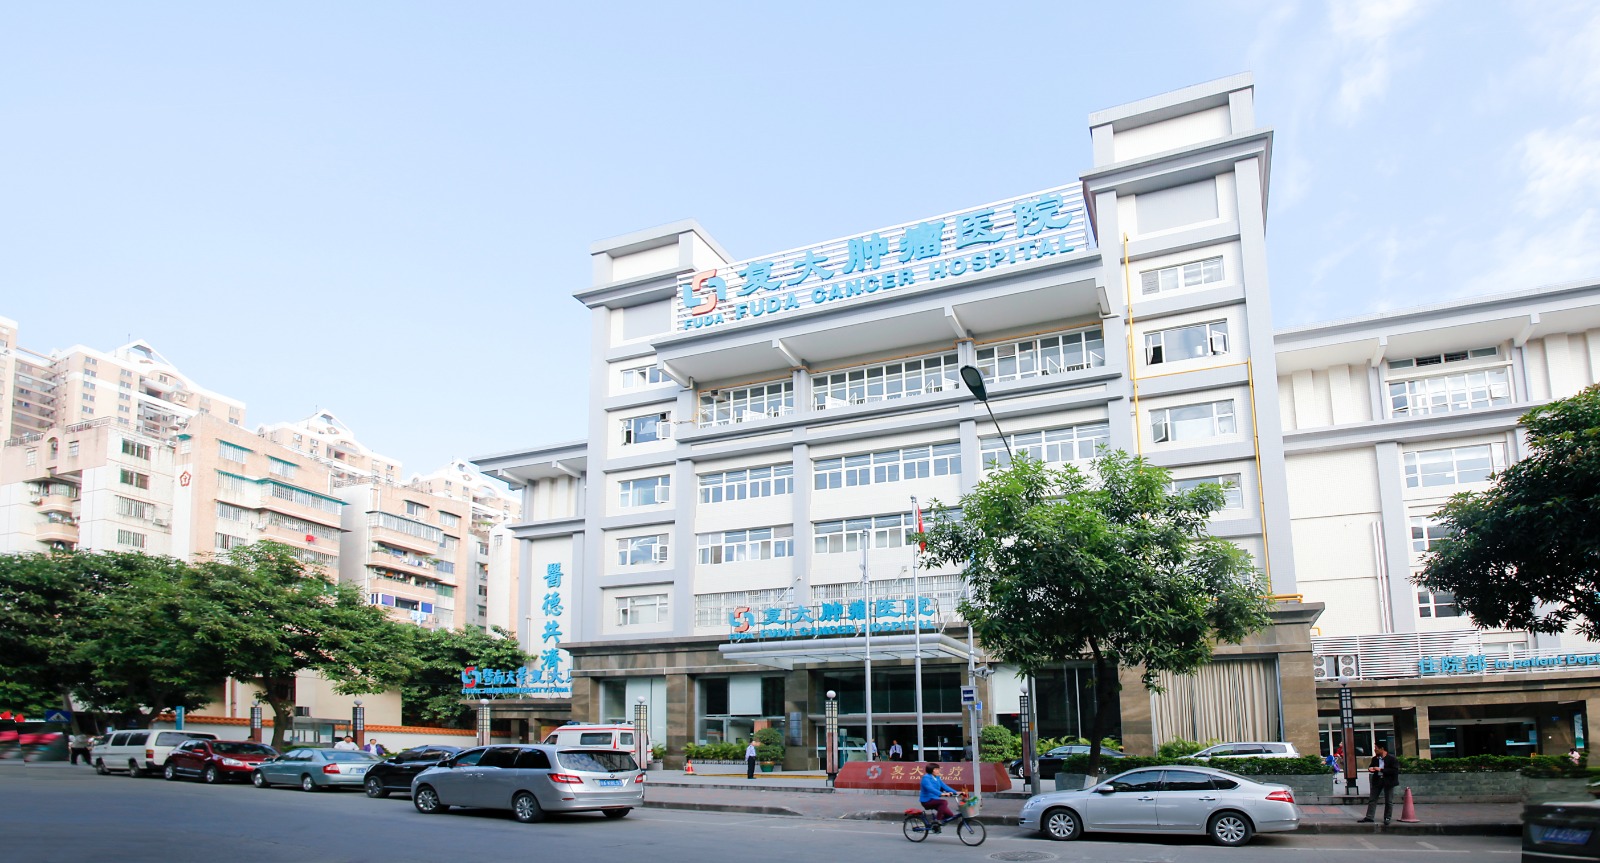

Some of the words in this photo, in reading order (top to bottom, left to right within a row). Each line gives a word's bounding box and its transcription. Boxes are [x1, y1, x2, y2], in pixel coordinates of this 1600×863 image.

[736, 193, 1073, 298] 复大肿瘤医院
[735, 292, 800, 321] FUDA
[811, 268, 916, 304] CANCER
[928, 235, 1075, 281] HOSPITAL
[682, 314, 726, 331] FUDA
[759, 595, 936, 625] 复大肿瘤医院
[728, 632, 755, 640] FUDA
[760, 627, 797, 638] FUDA
[800, 624, 856, 636] CANCER
[1418, 654, 1488, 674] 住院部
[1495, 655, 1562, 669] In-patient
